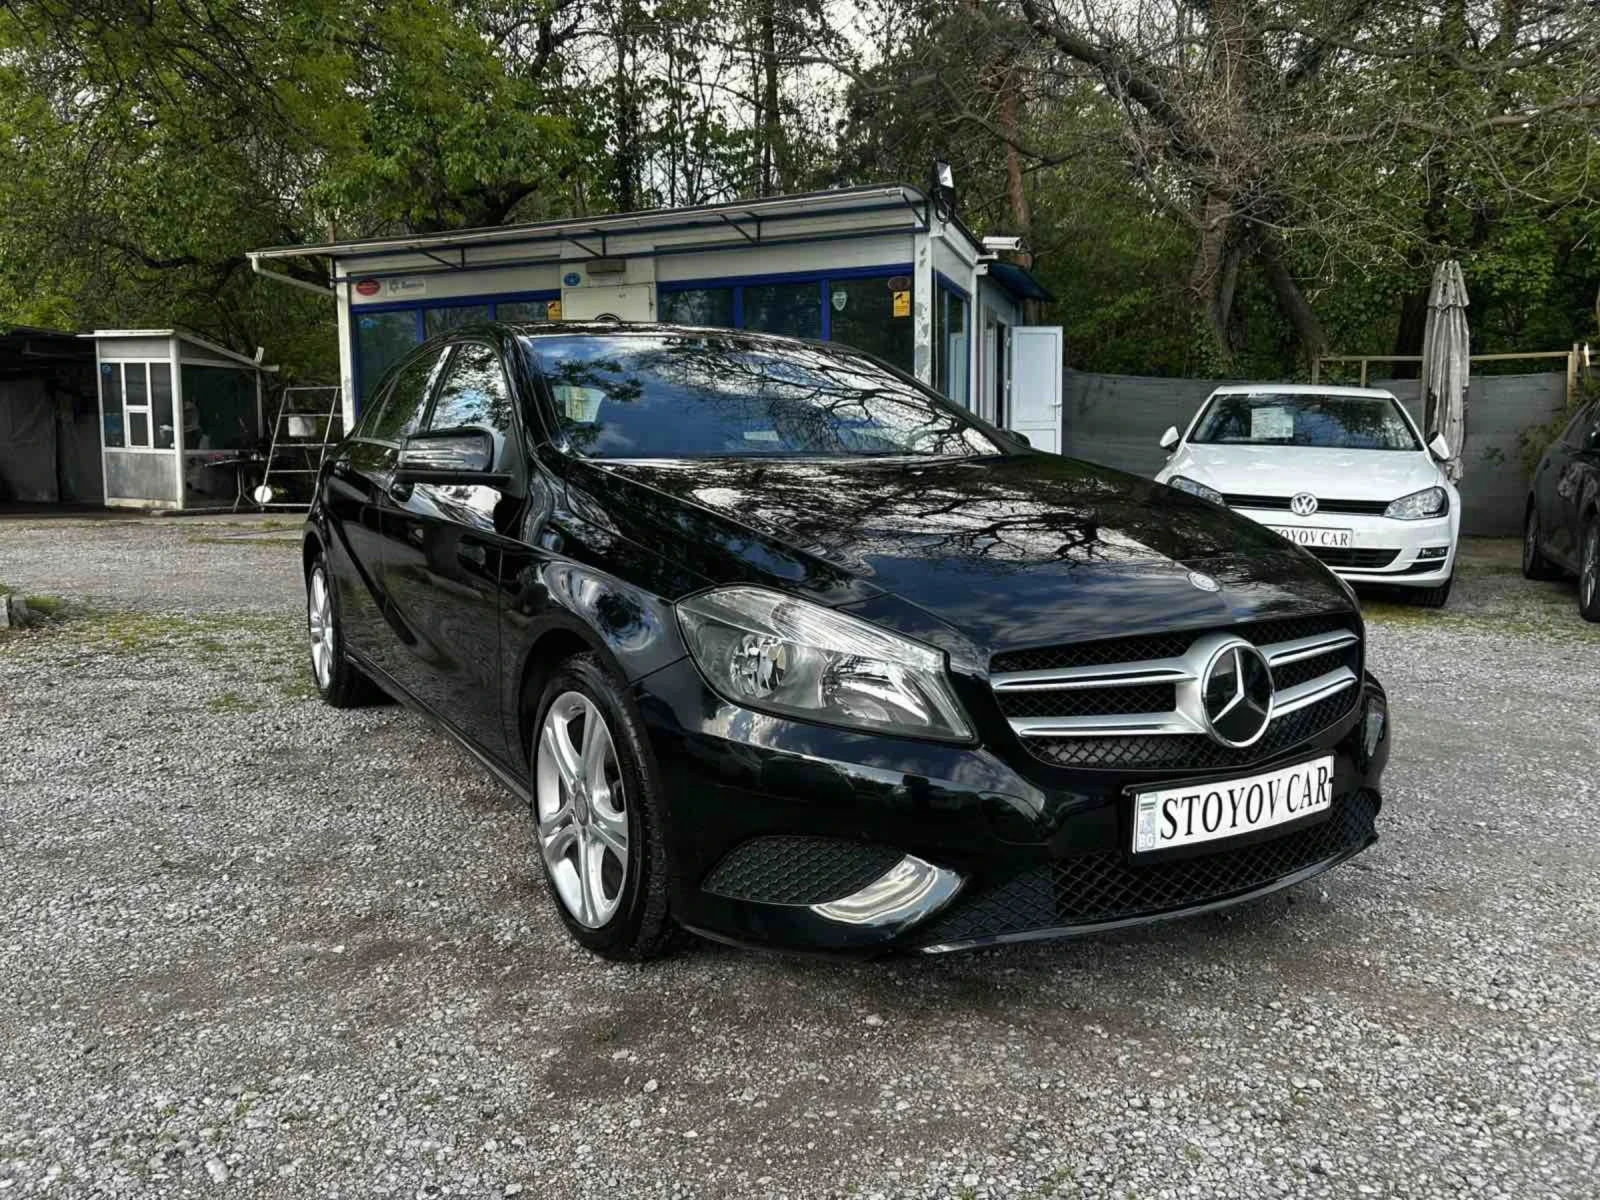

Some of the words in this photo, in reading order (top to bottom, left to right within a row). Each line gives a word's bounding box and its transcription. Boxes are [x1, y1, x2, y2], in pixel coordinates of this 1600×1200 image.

[1291, 492, 1317, 516] VW
[1321, 531, 1348, 546] CAR
[1160, 778, 1281, 840] STOYOV
[1286, 766, 1328, 814] CAR
